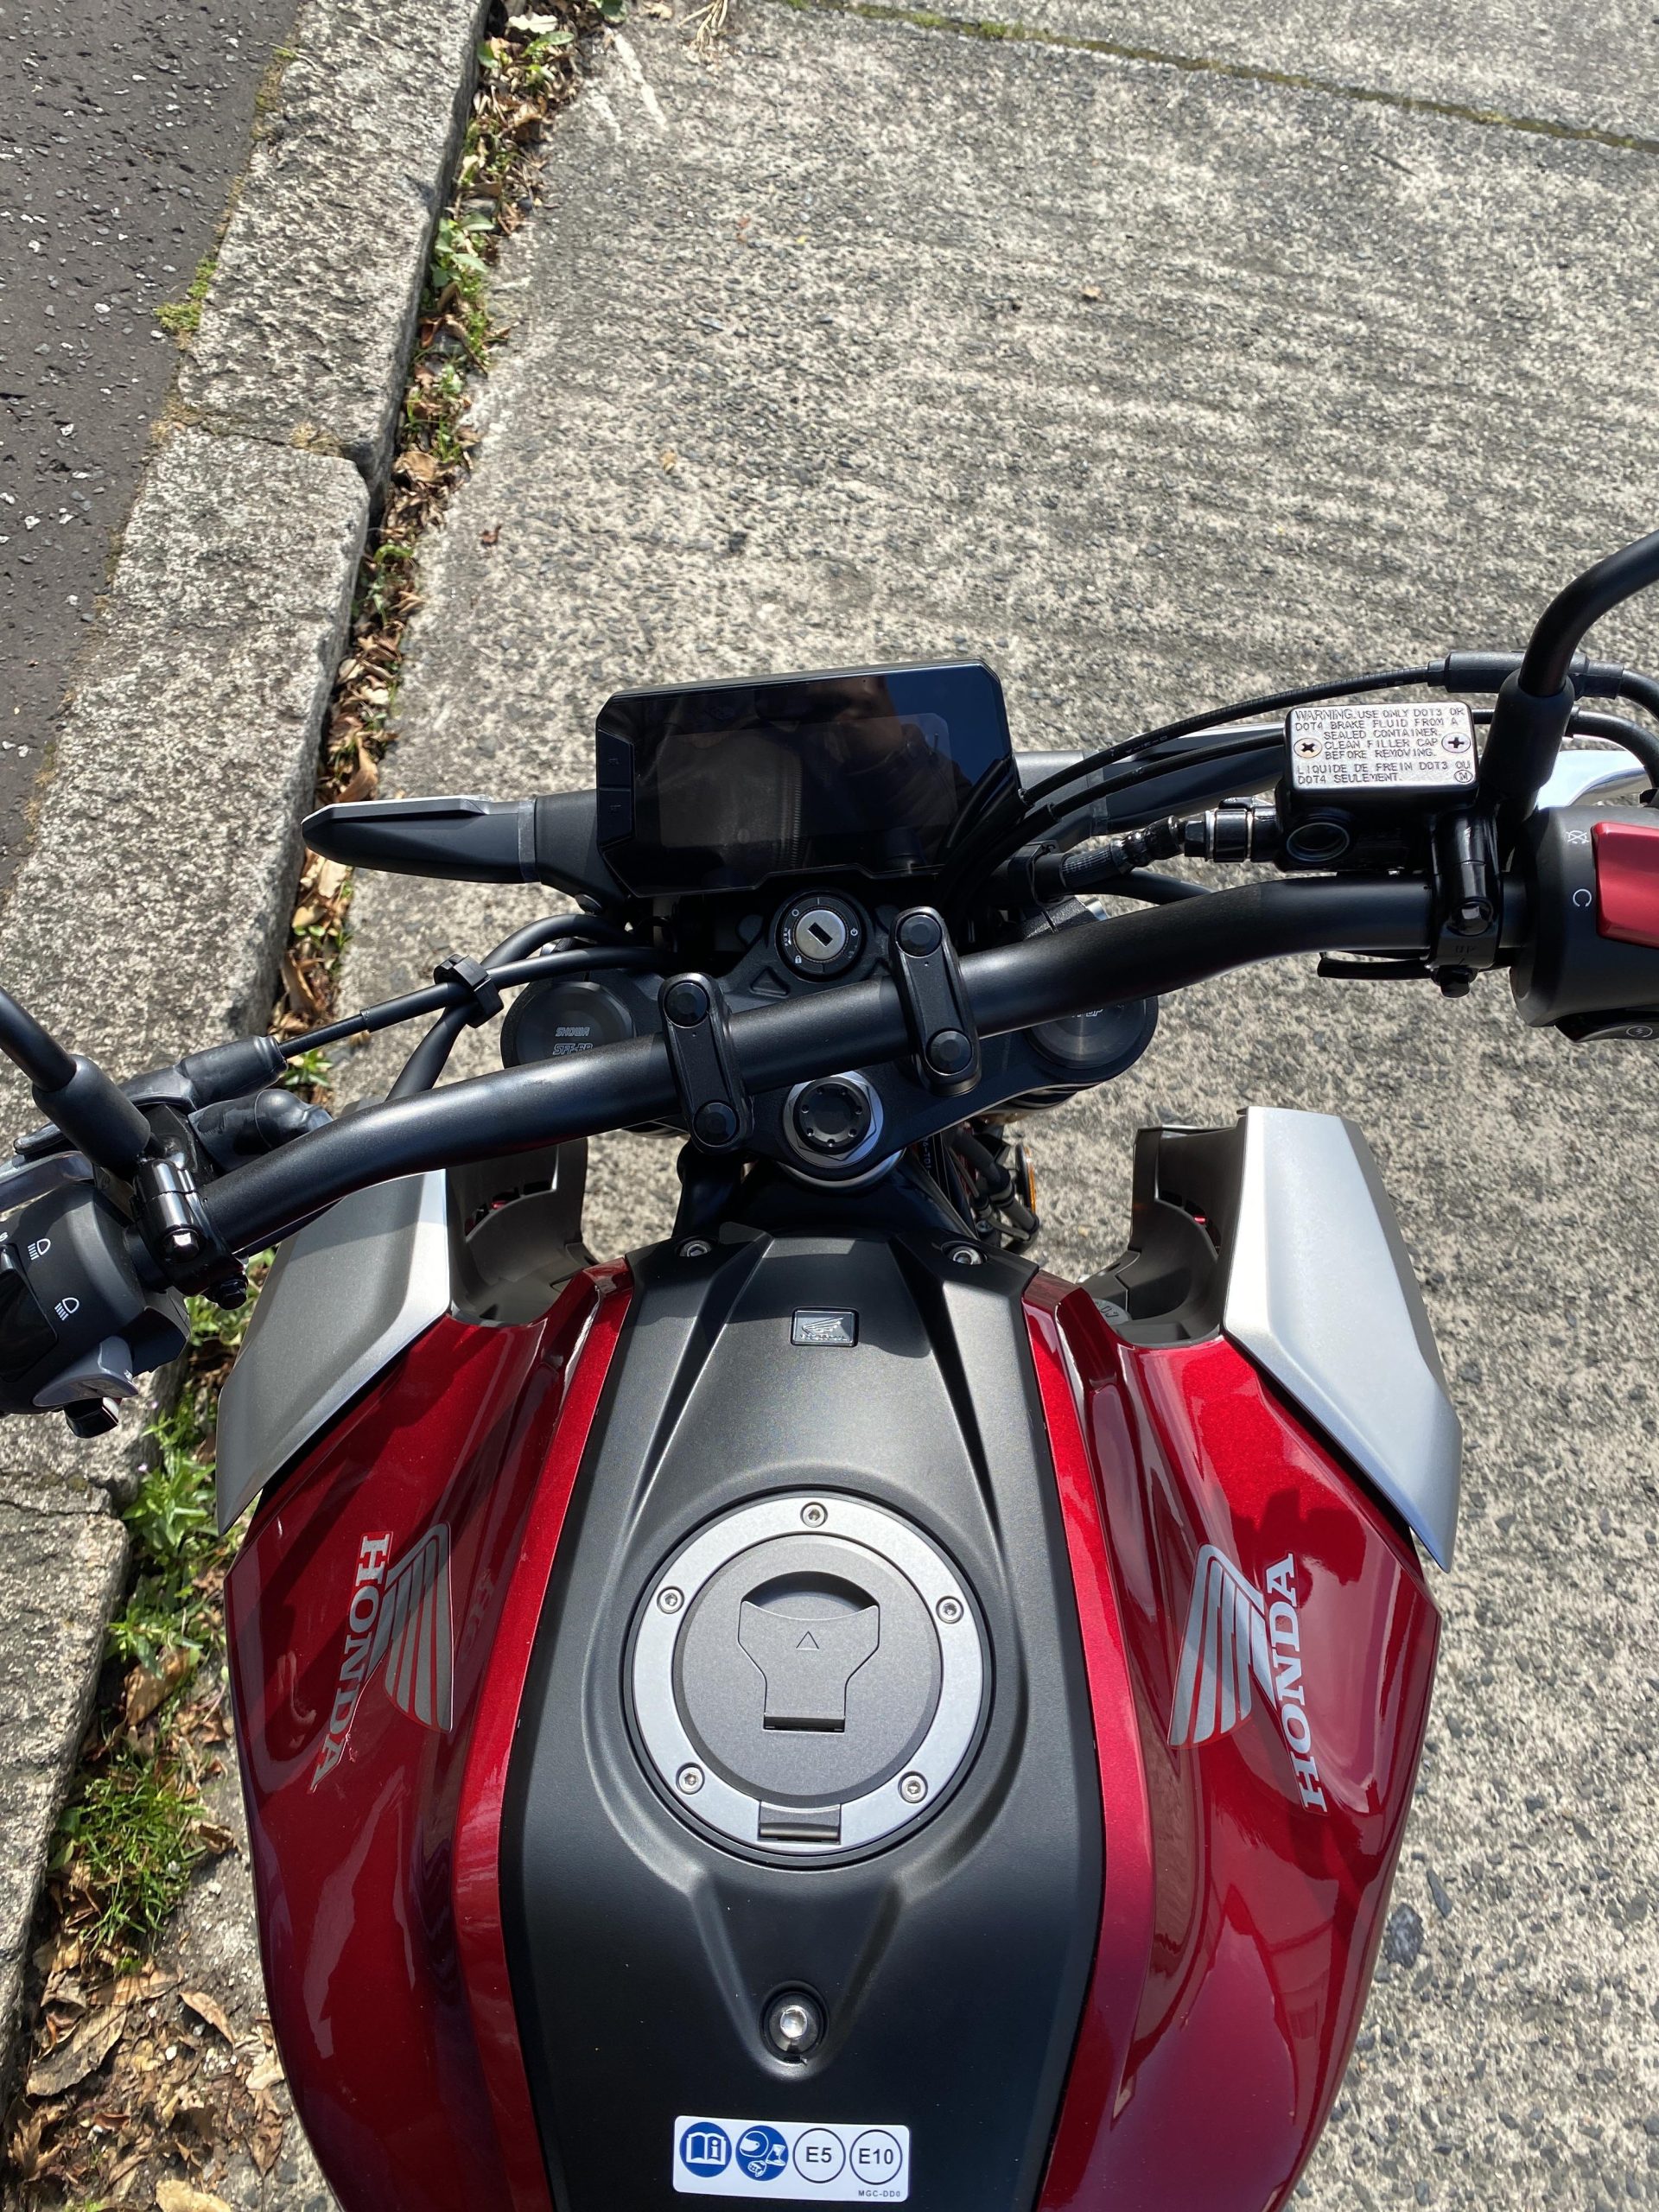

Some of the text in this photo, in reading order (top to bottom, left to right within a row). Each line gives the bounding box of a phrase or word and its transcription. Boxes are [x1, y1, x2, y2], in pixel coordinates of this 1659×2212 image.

[1357, 709, 1381, 719] USE
[1382, 709, 1408, 718] ONLY
[1414, 708, 1443, 717] DOT3
[1295, 717, 1459, 731] DOT4 BRAKE FLUID FROM A
[1324, 728, 1441, 740] SEALED CONTAINER.
[1325, 737, 1438, 750] CLEAN FILLER CAP
[1325, 748, 1437, 760] BEFORE REMOVING.
[1297, 760, 1471, 774] LIQUIDE DE FREIN DOT3 OU
[1298, 772, 1402, 785] DOT4 SEULEMENT.
[555, 1027, 590, 1037] SHOWA
[310, 1533, 391, 1791] HONDA
[1266, 1553, 1328, 1813] HONDA
[805, 2146, 894, 2164] E5 E10
